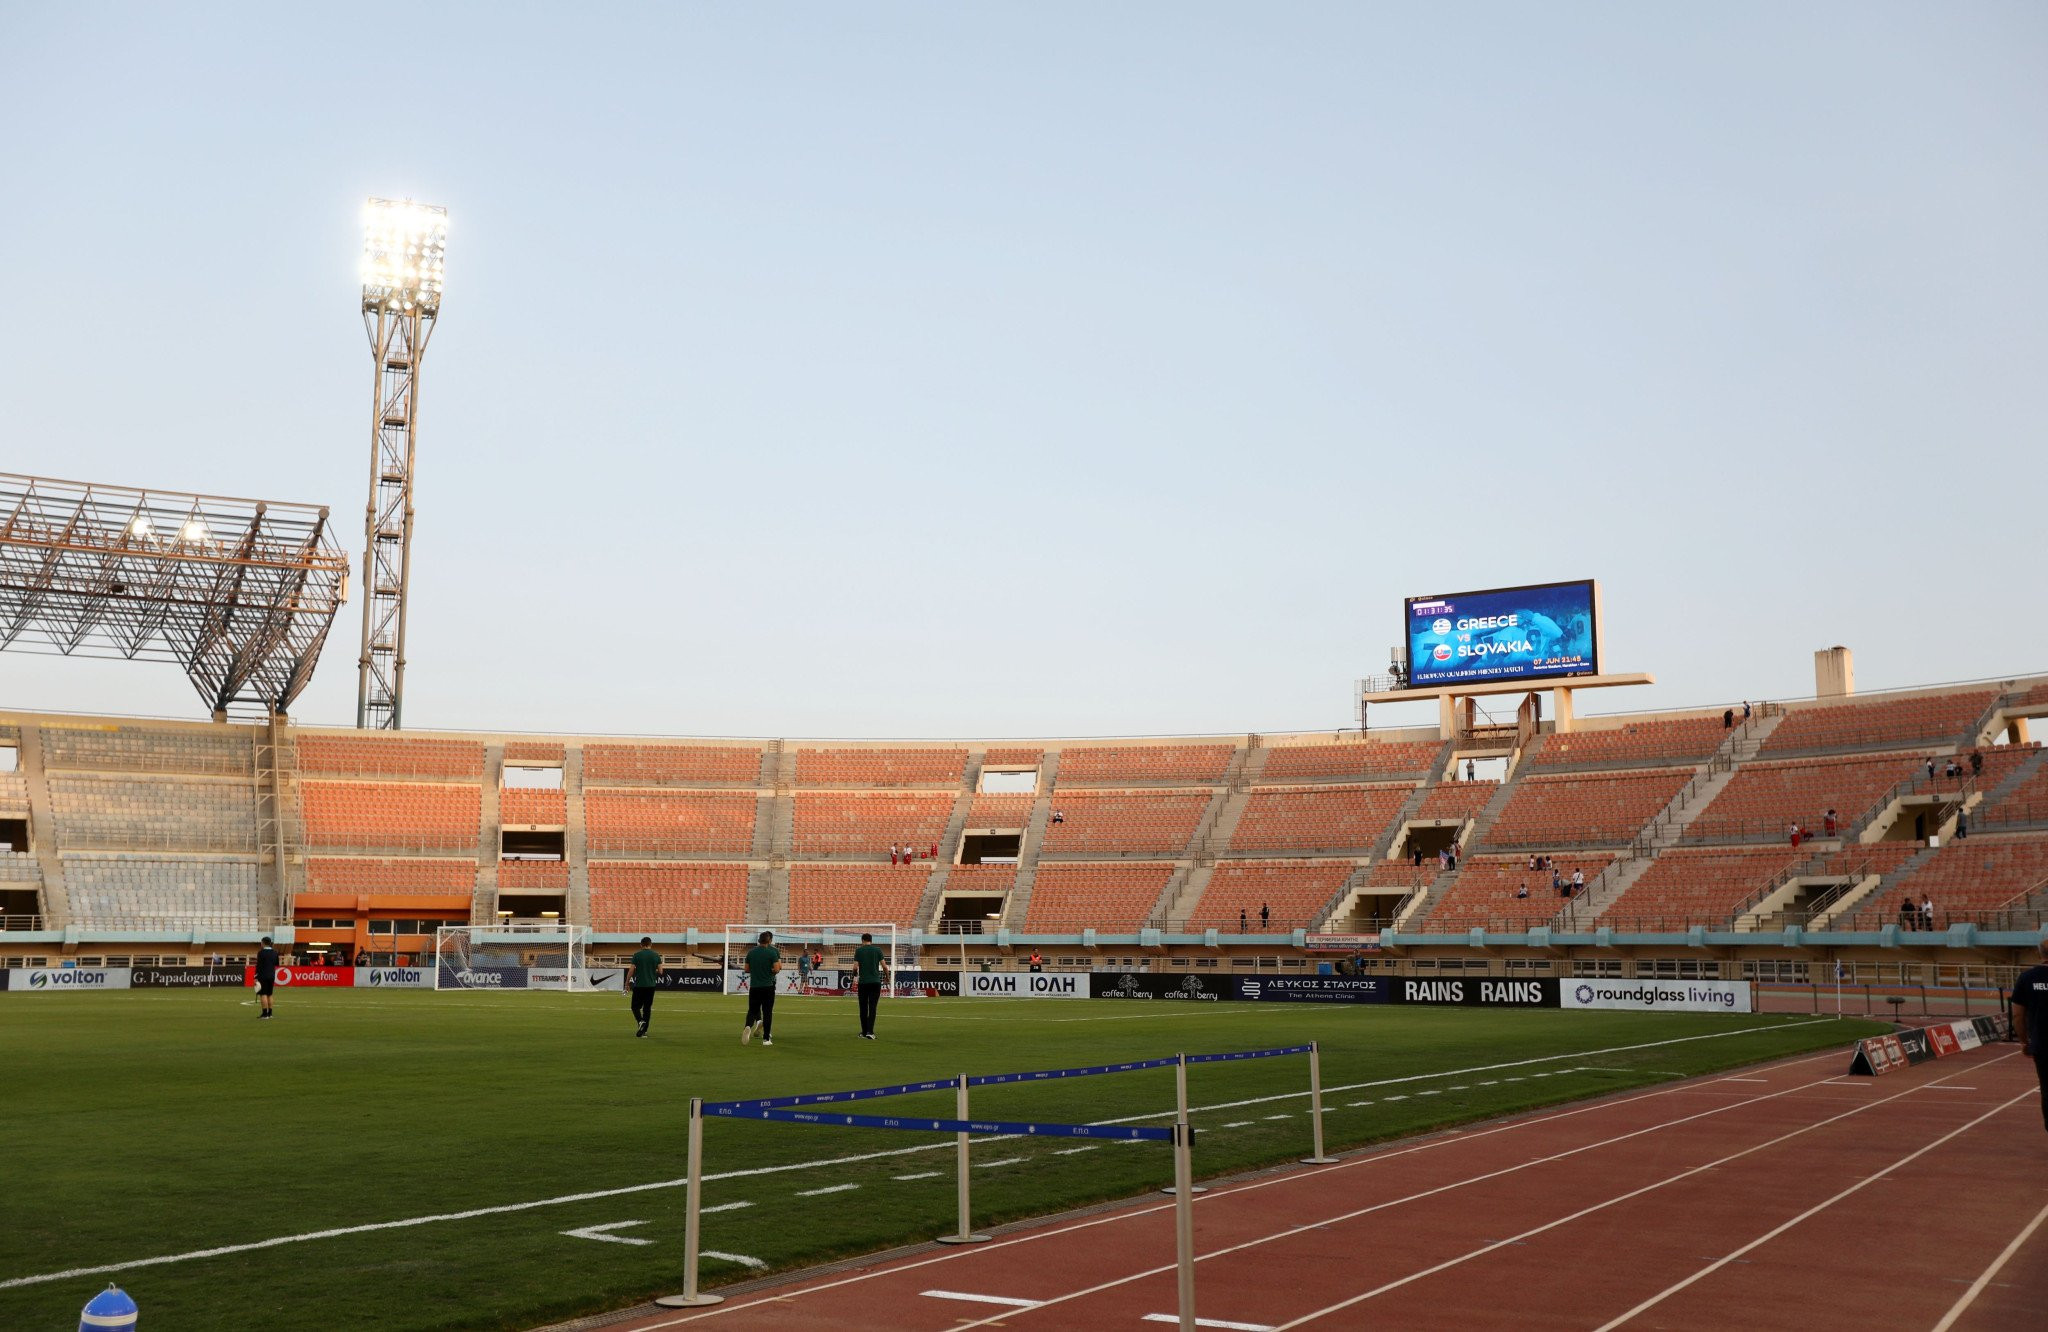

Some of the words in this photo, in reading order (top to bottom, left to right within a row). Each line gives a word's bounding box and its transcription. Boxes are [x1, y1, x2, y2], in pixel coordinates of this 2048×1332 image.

[1456, 614, 1518, 631] GREECE
[1458, 640, 1533, 657] SLOVAKIA
[1533, 658, 1543, 666] 07
[1546, 657, 1560, 665] JUN
[52, 970, 105, 984] volton
[133, 971, 147, 984] G.
[150, 972, 243, 986] Papadogamyros
[295, 971, 338, 981] vodafone
[384, 968, 420, 982] volton
[678, 977, 715, 985] AEGEAN
[1267, 980, 1319, 988] ΛΕΥΚΟΣ
[1323, 981, 1377, 989] ΣΤΑΥΡΟΣ
[1405, 981, 1464, 1002] RAINS
[2032, 982, 2048, 991] HEL
[1101, 990, 1125, 998] coffee
[1132, 990, 1153, 1000] berry
[1164, 991, 1188, 999] coffee
[1196, 991, 1218, 1001] berry
[1480, 982, 1543, 1003] RAINS
[1596, 986, 1685, 1005] roundglass
[1688, 987, 1735, 1007] living
